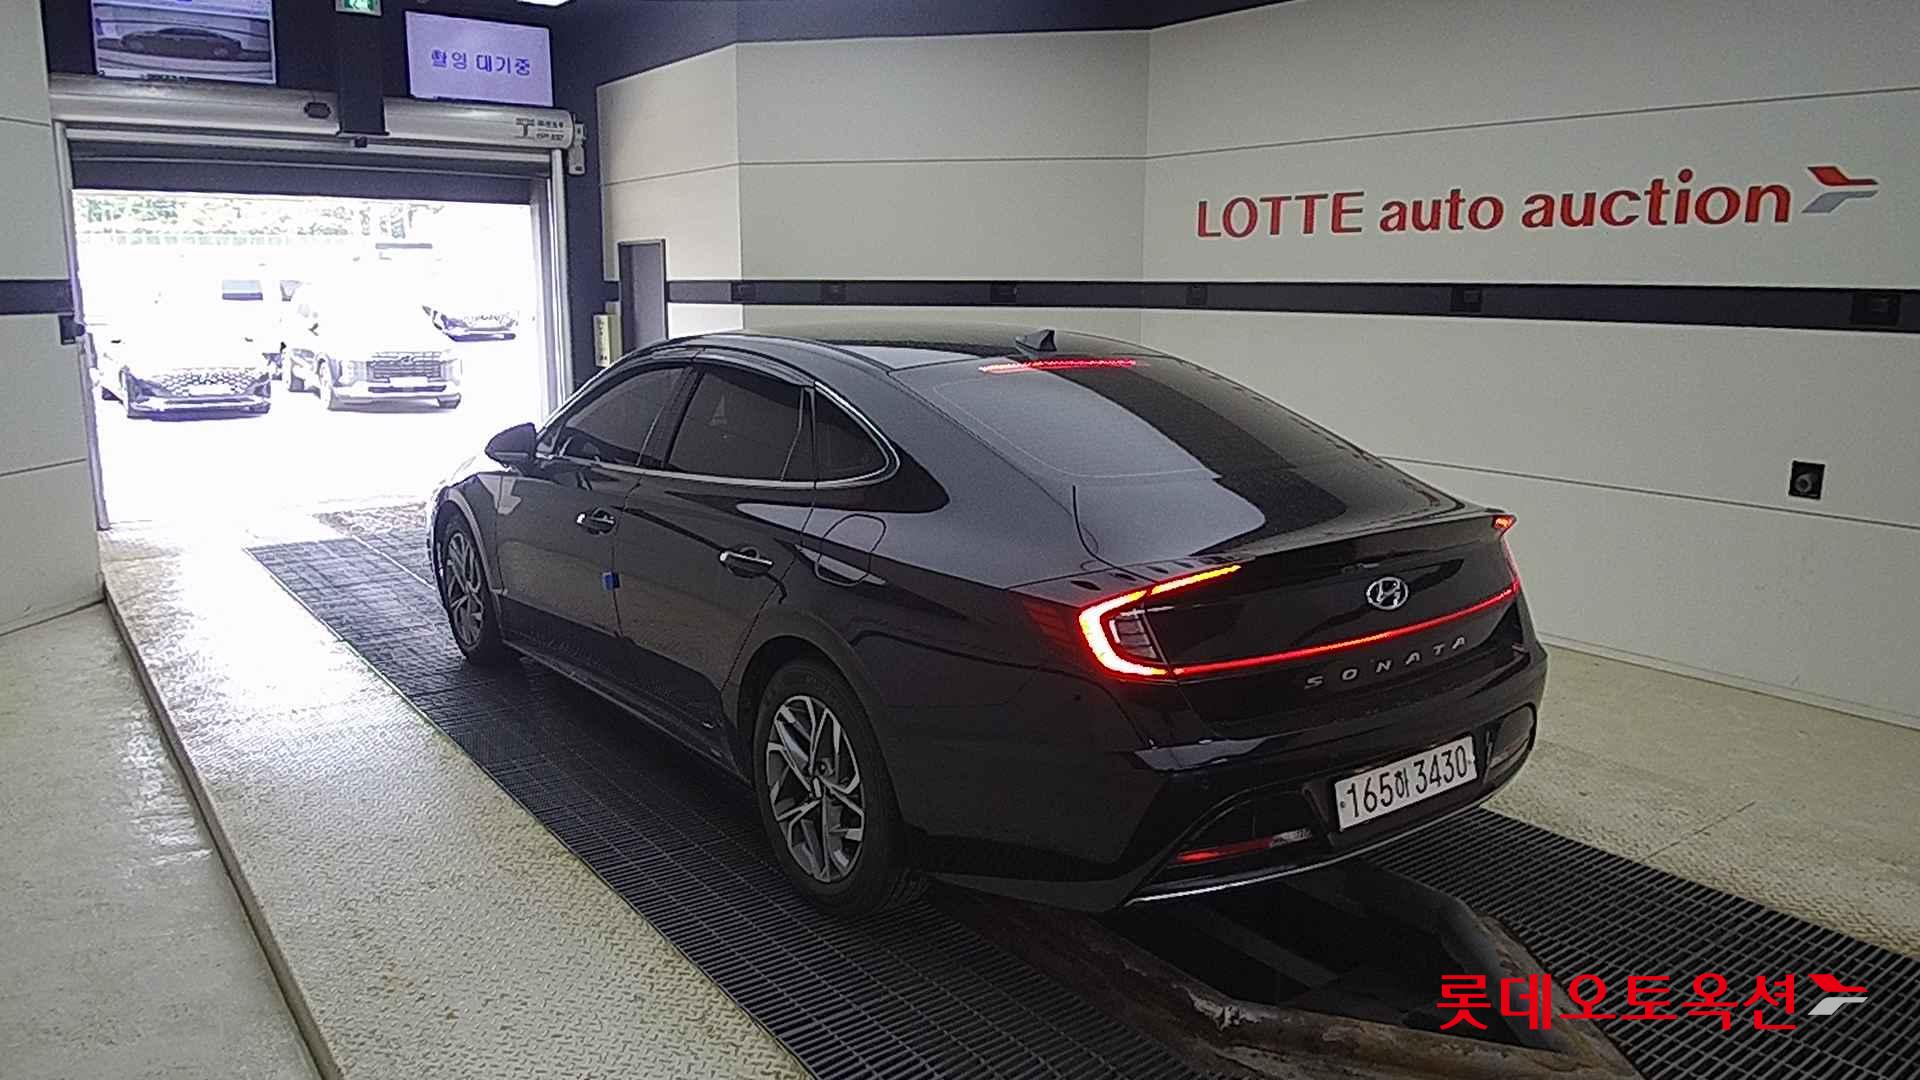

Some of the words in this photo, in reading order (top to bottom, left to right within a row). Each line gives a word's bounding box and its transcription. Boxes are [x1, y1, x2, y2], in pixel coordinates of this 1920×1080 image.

[476, 53, 531, 76] 대기중
[1197, 191, 1365, 238] LOTTE
[1379, 189, 1505, 233] auto
[1521, 168, 1792, 228] auction
[1303, 635, 1468, 690] SONATA
[1413, 745, 1468, 795] 3430
